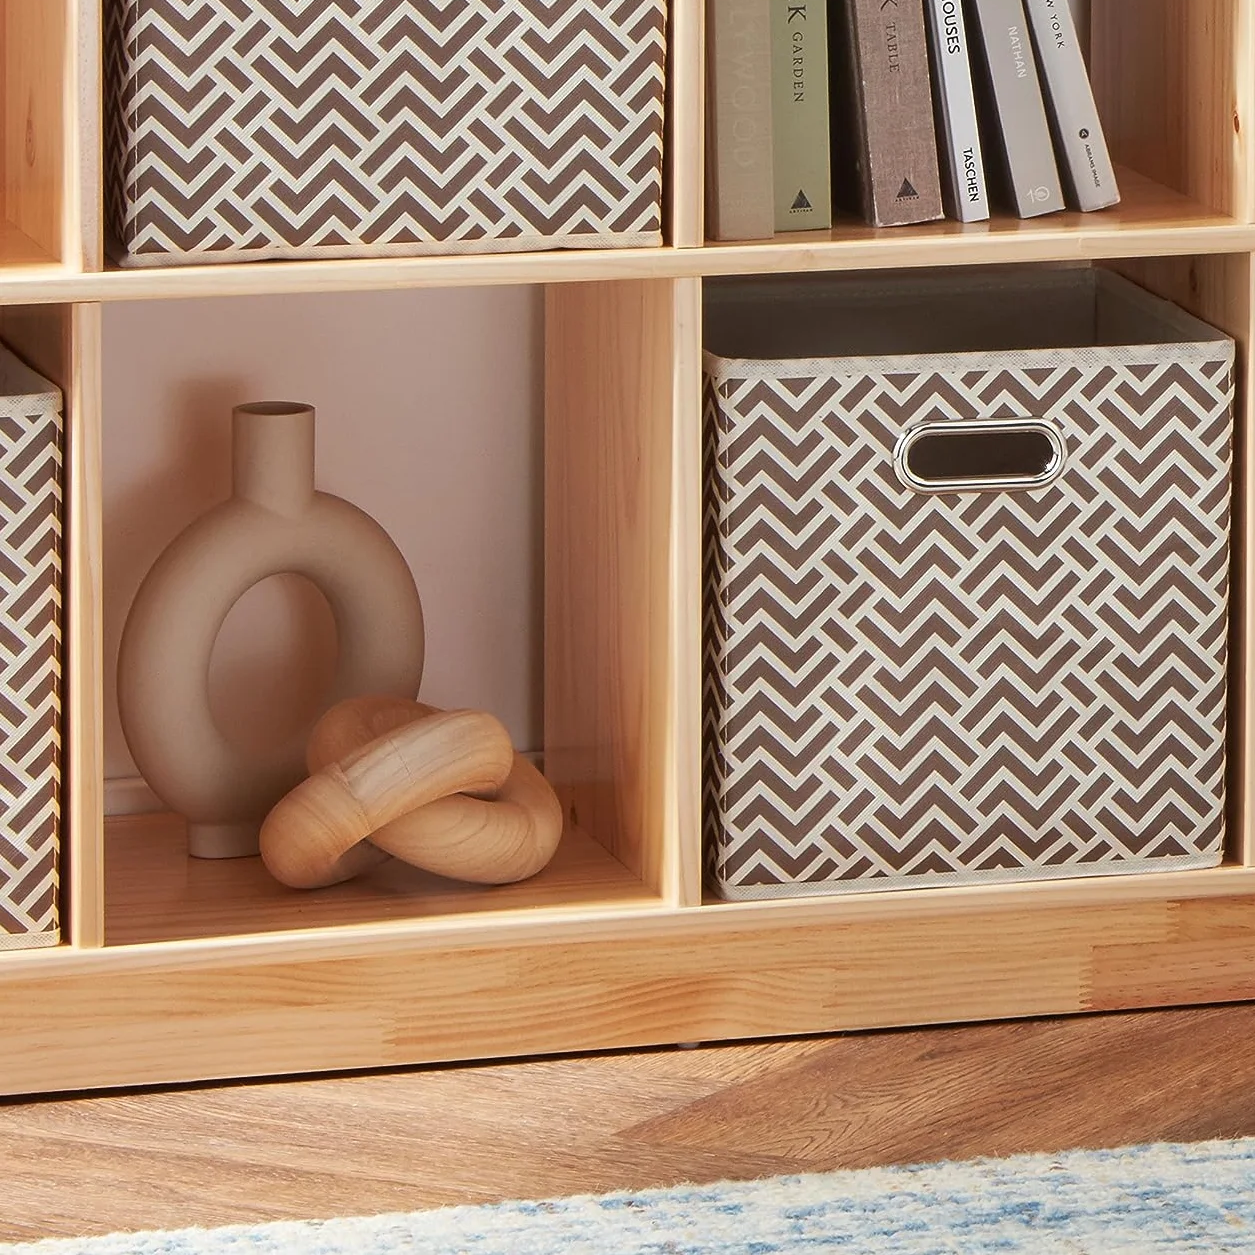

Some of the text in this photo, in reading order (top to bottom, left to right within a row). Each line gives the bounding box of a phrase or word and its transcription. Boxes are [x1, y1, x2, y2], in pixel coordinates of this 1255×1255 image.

[885, 21, 900, 73] TABLE
[1008, 26, 1027, 78] NATHAN
[1050, 13, 1065, 49] YORK
[791, 31, 805, 102] GARDEN
[963, 147, 979, 202] TASCHEN
